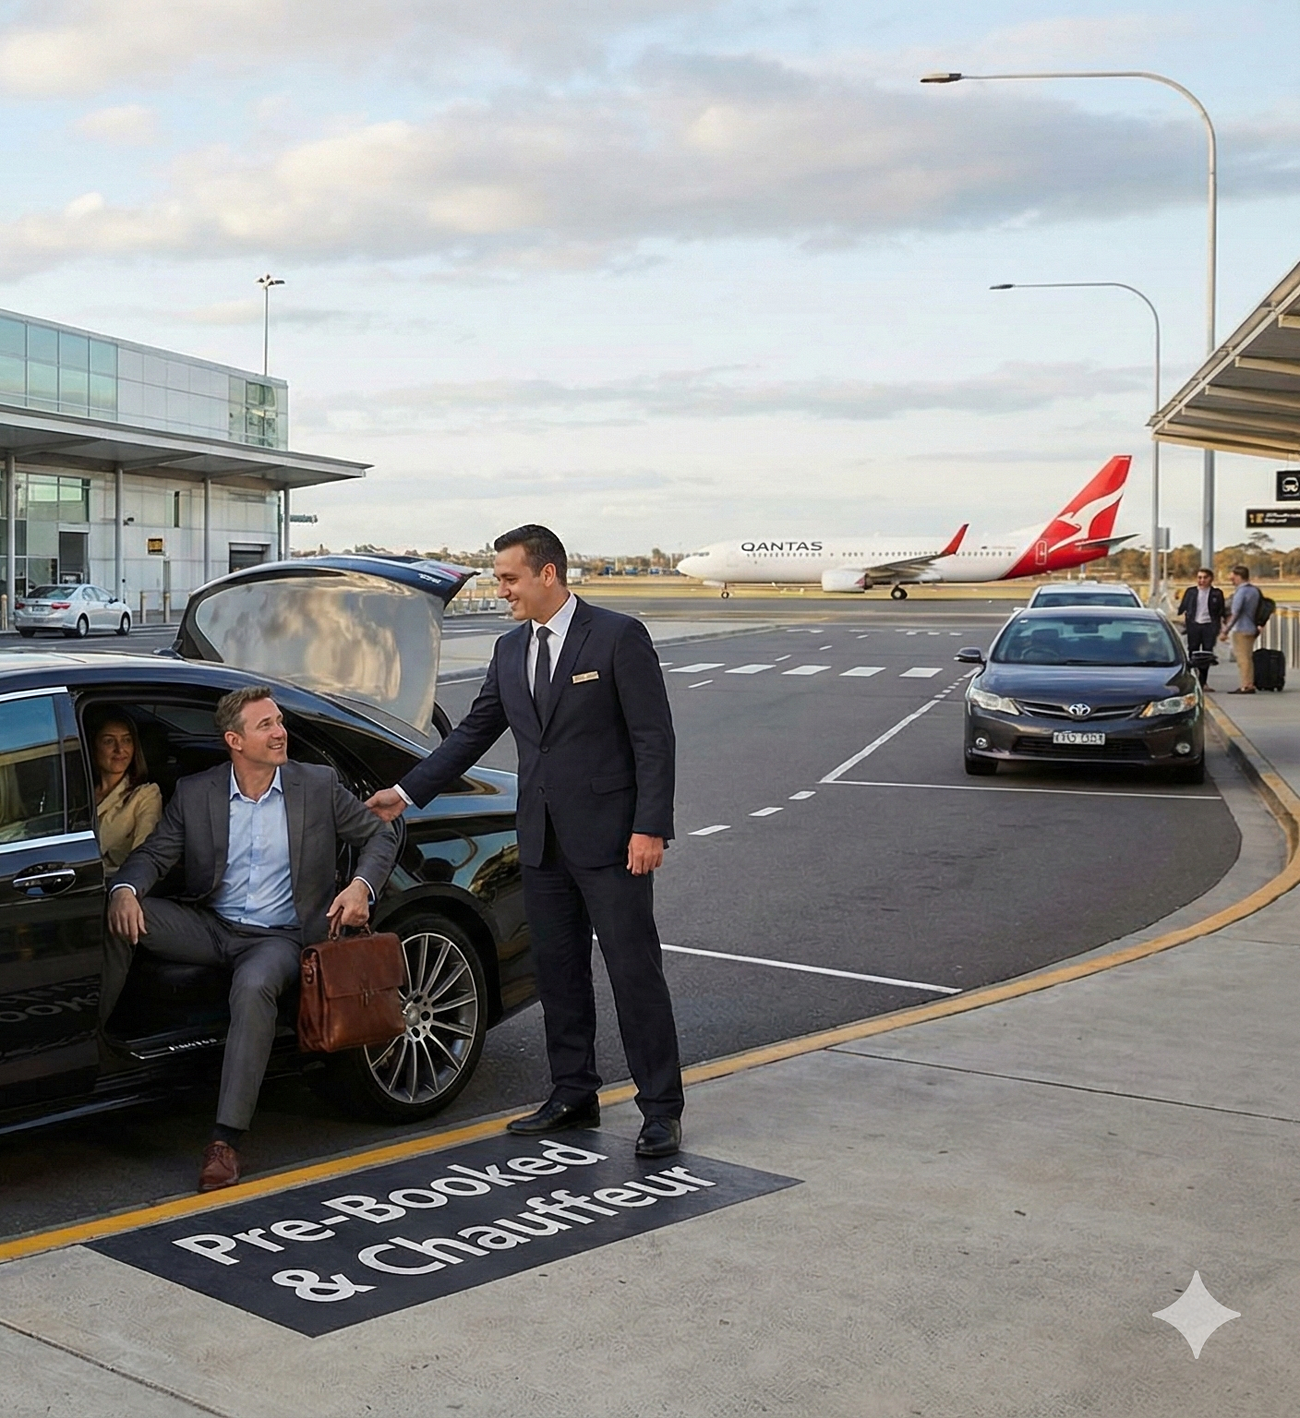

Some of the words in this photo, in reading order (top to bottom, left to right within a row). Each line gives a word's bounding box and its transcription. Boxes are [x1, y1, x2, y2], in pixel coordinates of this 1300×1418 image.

[741, 541, 823, 552] QANTAS
[171, 1139, 609, 1266] Pre-Booked
[271, 1268, 377, 1303] &
[357, 1164, 717, 1276] Chauffeur
